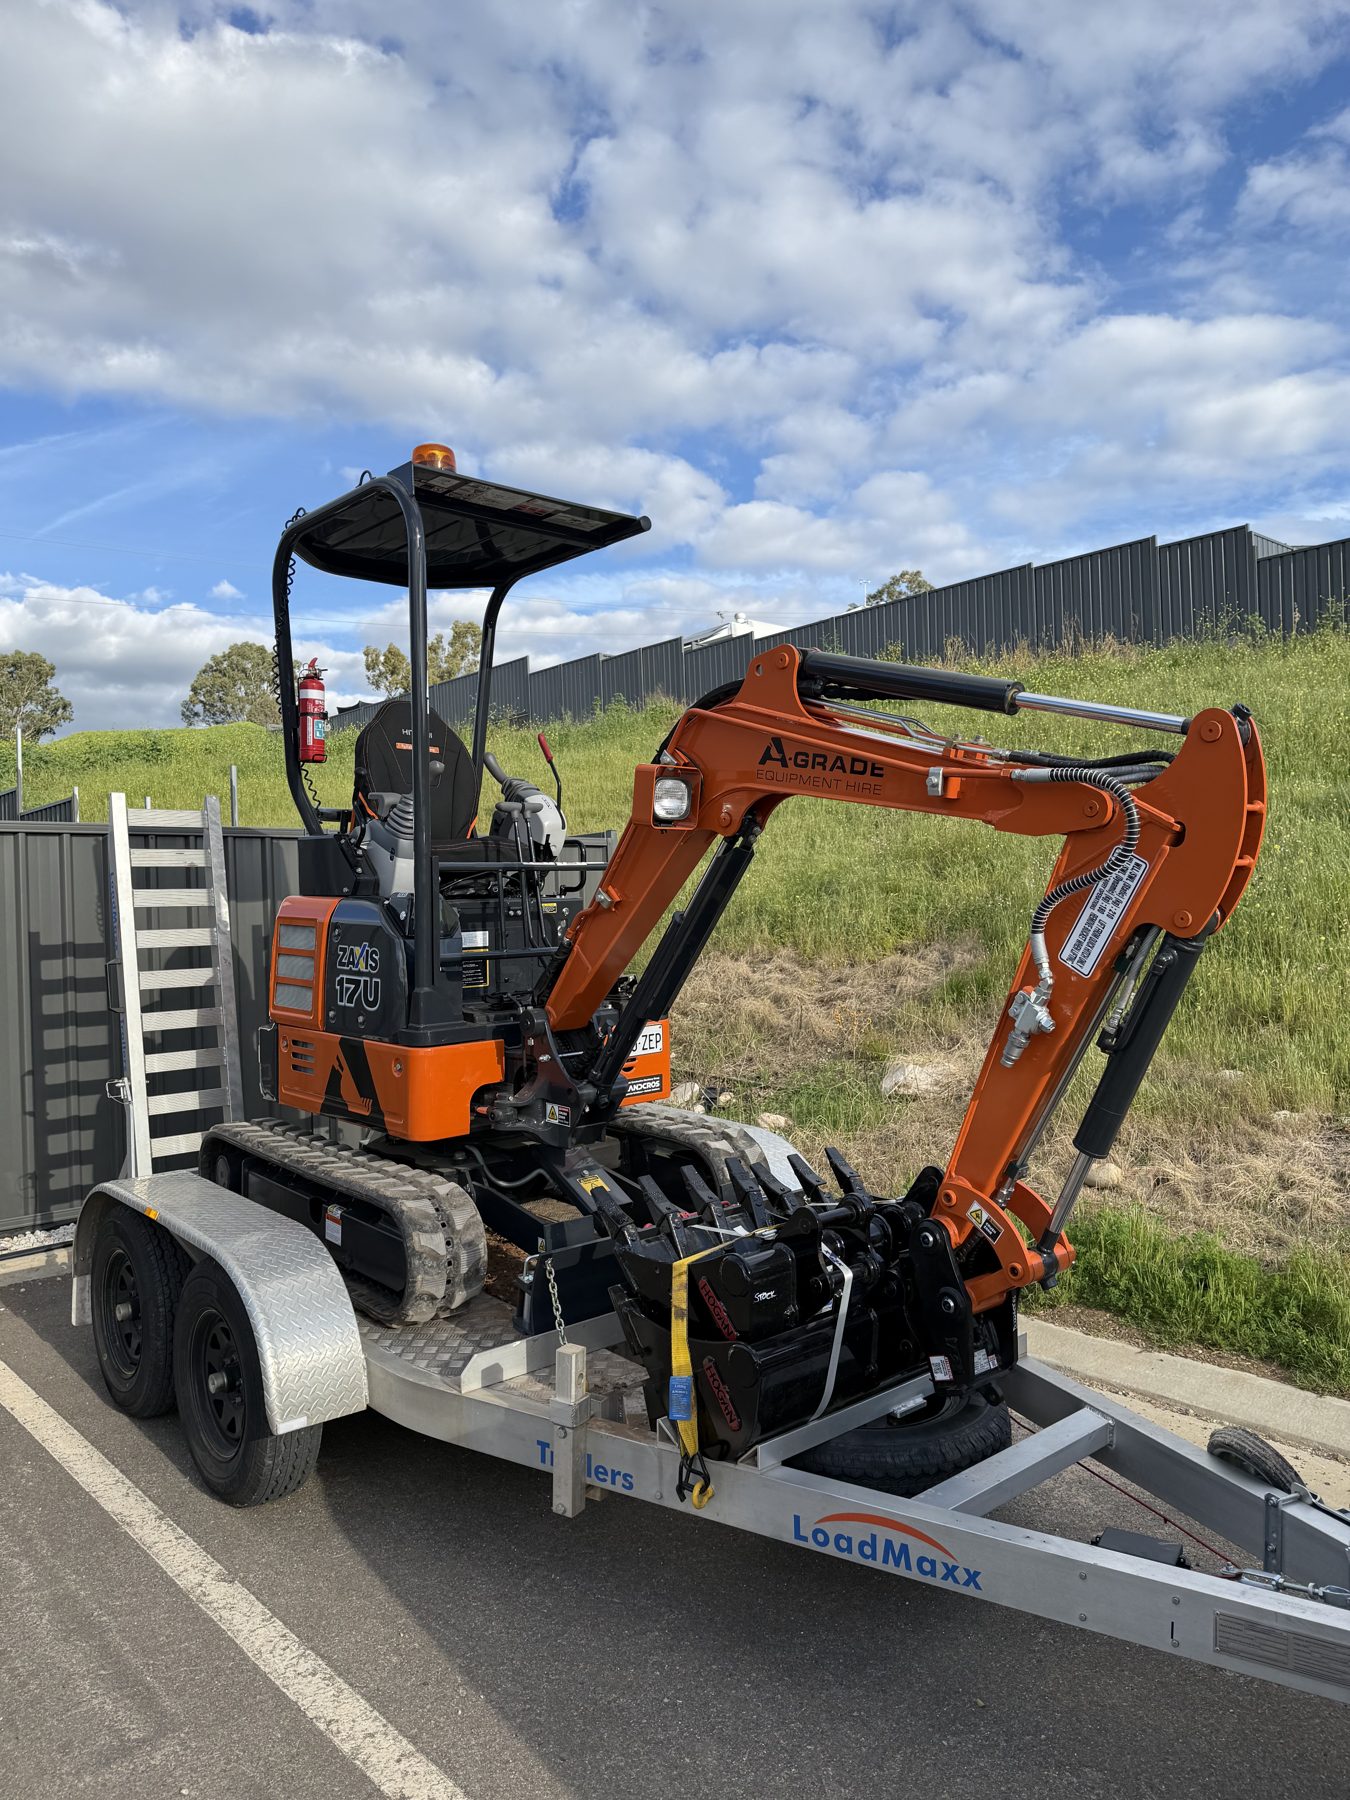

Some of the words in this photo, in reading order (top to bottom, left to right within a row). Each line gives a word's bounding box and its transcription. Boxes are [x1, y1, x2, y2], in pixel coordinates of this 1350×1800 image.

[756, 769, 842, 791] EQUIPMENT
[845, 780, 883, 796] HIRE
[1106, 909, 1115, 919] 210
[336, 942, 380, 973] ZAXIS
[335, 974, 381, 1011] 17U
[627, 1081, 660, 1092] ANDCROS
[700, 1283, 734, 1337] HOGAN
[705, 1366, 737, 1424] HOGAN
[793, 1514, 983, 1591] LoadMaxx
